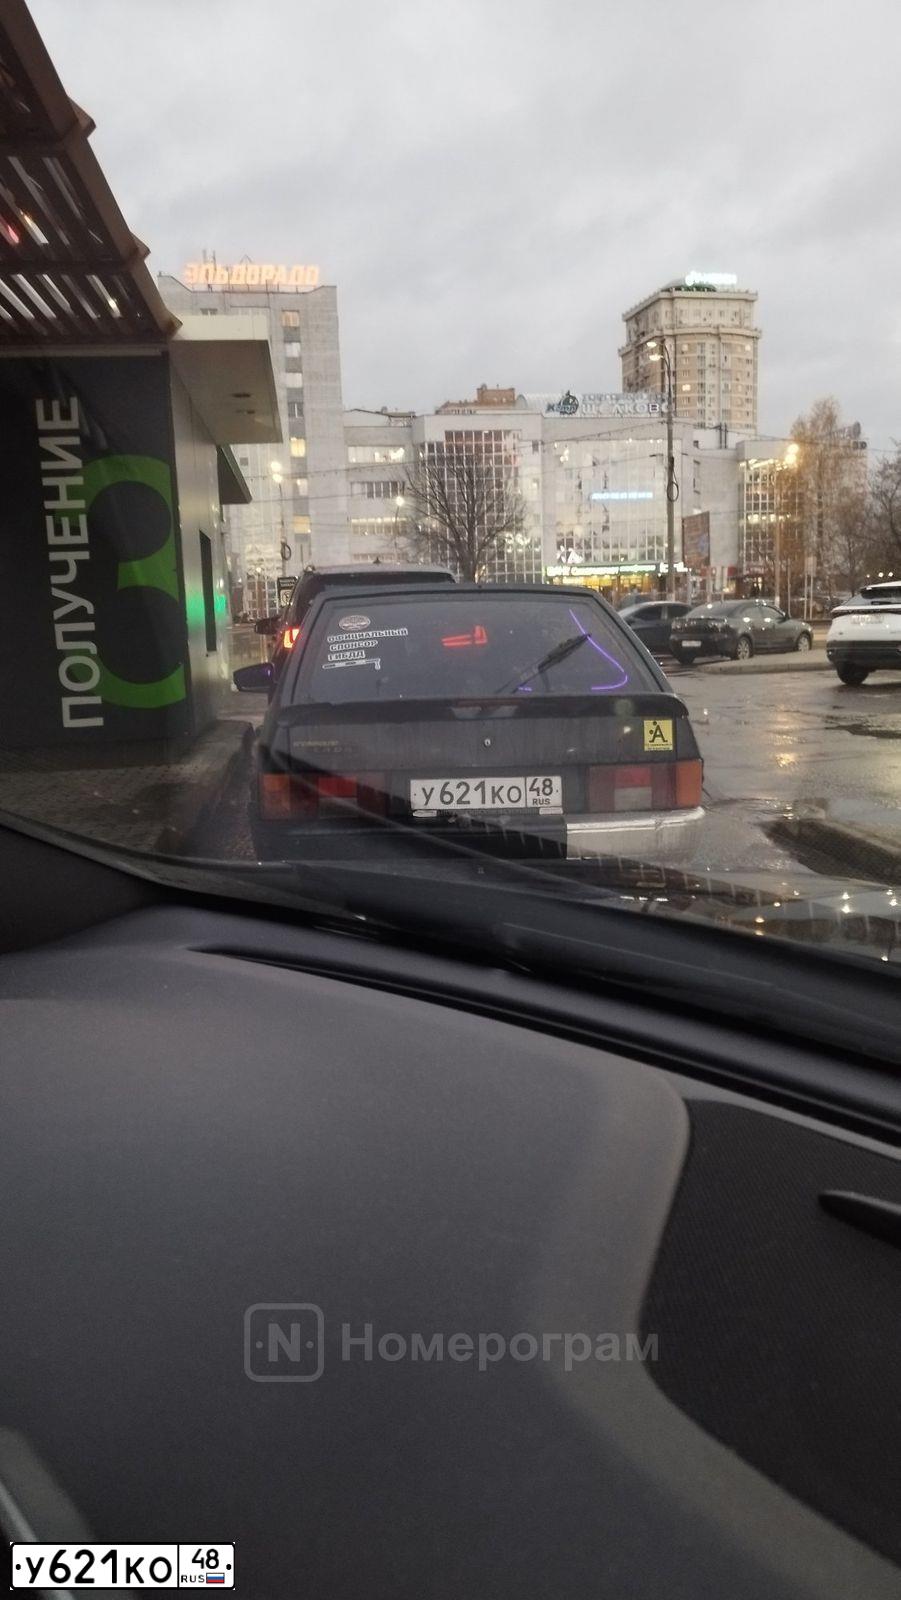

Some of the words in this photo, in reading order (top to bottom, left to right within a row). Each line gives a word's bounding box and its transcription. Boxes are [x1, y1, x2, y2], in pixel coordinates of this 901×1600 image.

[36, 397, 104, 728] ПОЛУЧЕНИЕ
[327, 628, 408, 642] ОФИЦИАЛЬНЫЙ
[329, 640, 378, 651] СПОНСОР
[328, 650, 366, 661] ГИБДД
[529, 777, 553, 797] 48
[532, 798, 550, 806] RUS
